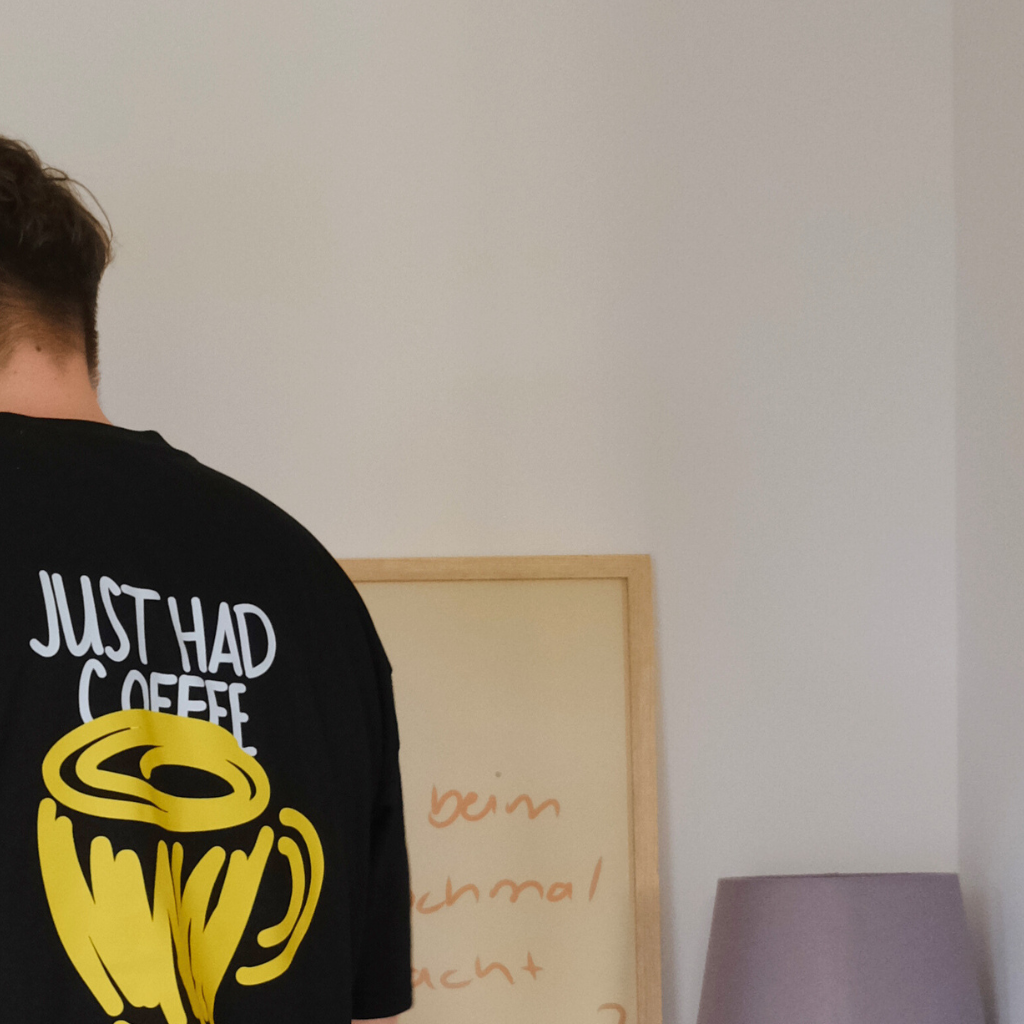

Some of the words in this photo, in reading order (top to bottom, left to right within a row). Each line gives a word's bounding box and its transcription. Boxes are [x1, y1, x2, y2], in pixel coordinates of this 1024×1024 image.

[29, 569, 161, 665] JUST
[167, 596, 277, 679] HAD
[78, 658, 258, 757] COFFEE
[410, 857, 603, 915] chmal
